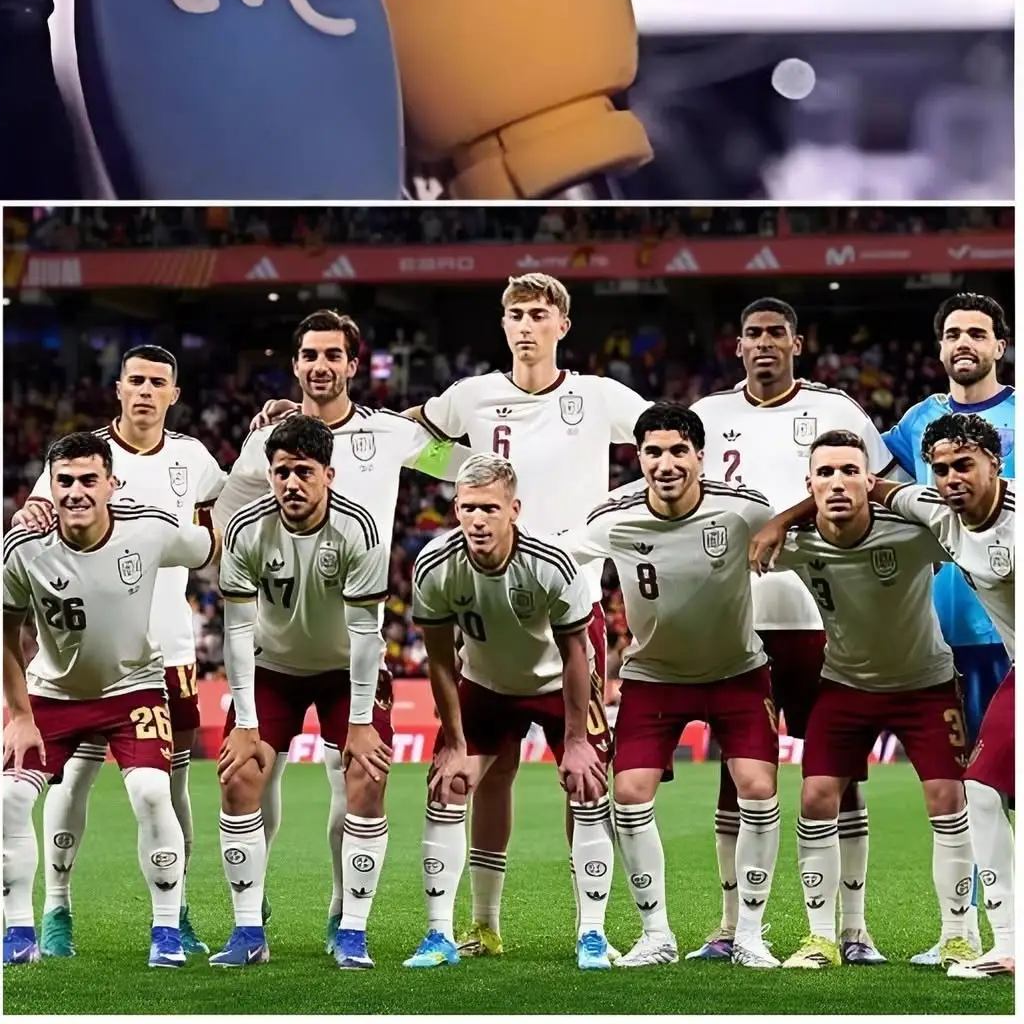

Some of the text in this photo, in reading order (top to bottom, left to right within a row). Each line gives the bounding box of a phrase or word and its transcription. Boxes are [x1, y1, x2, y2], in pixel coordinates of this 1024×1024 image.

[492, 425, 512, 460] 6
[723, 449, 742, 483] 2
[260, 576, 295, 609] 17
[636, 562, 659, 601] 8
[41, 597, 87, 631] 26
[129, 705, 173, 743] 26
[943, 708, 966, 747] 3
